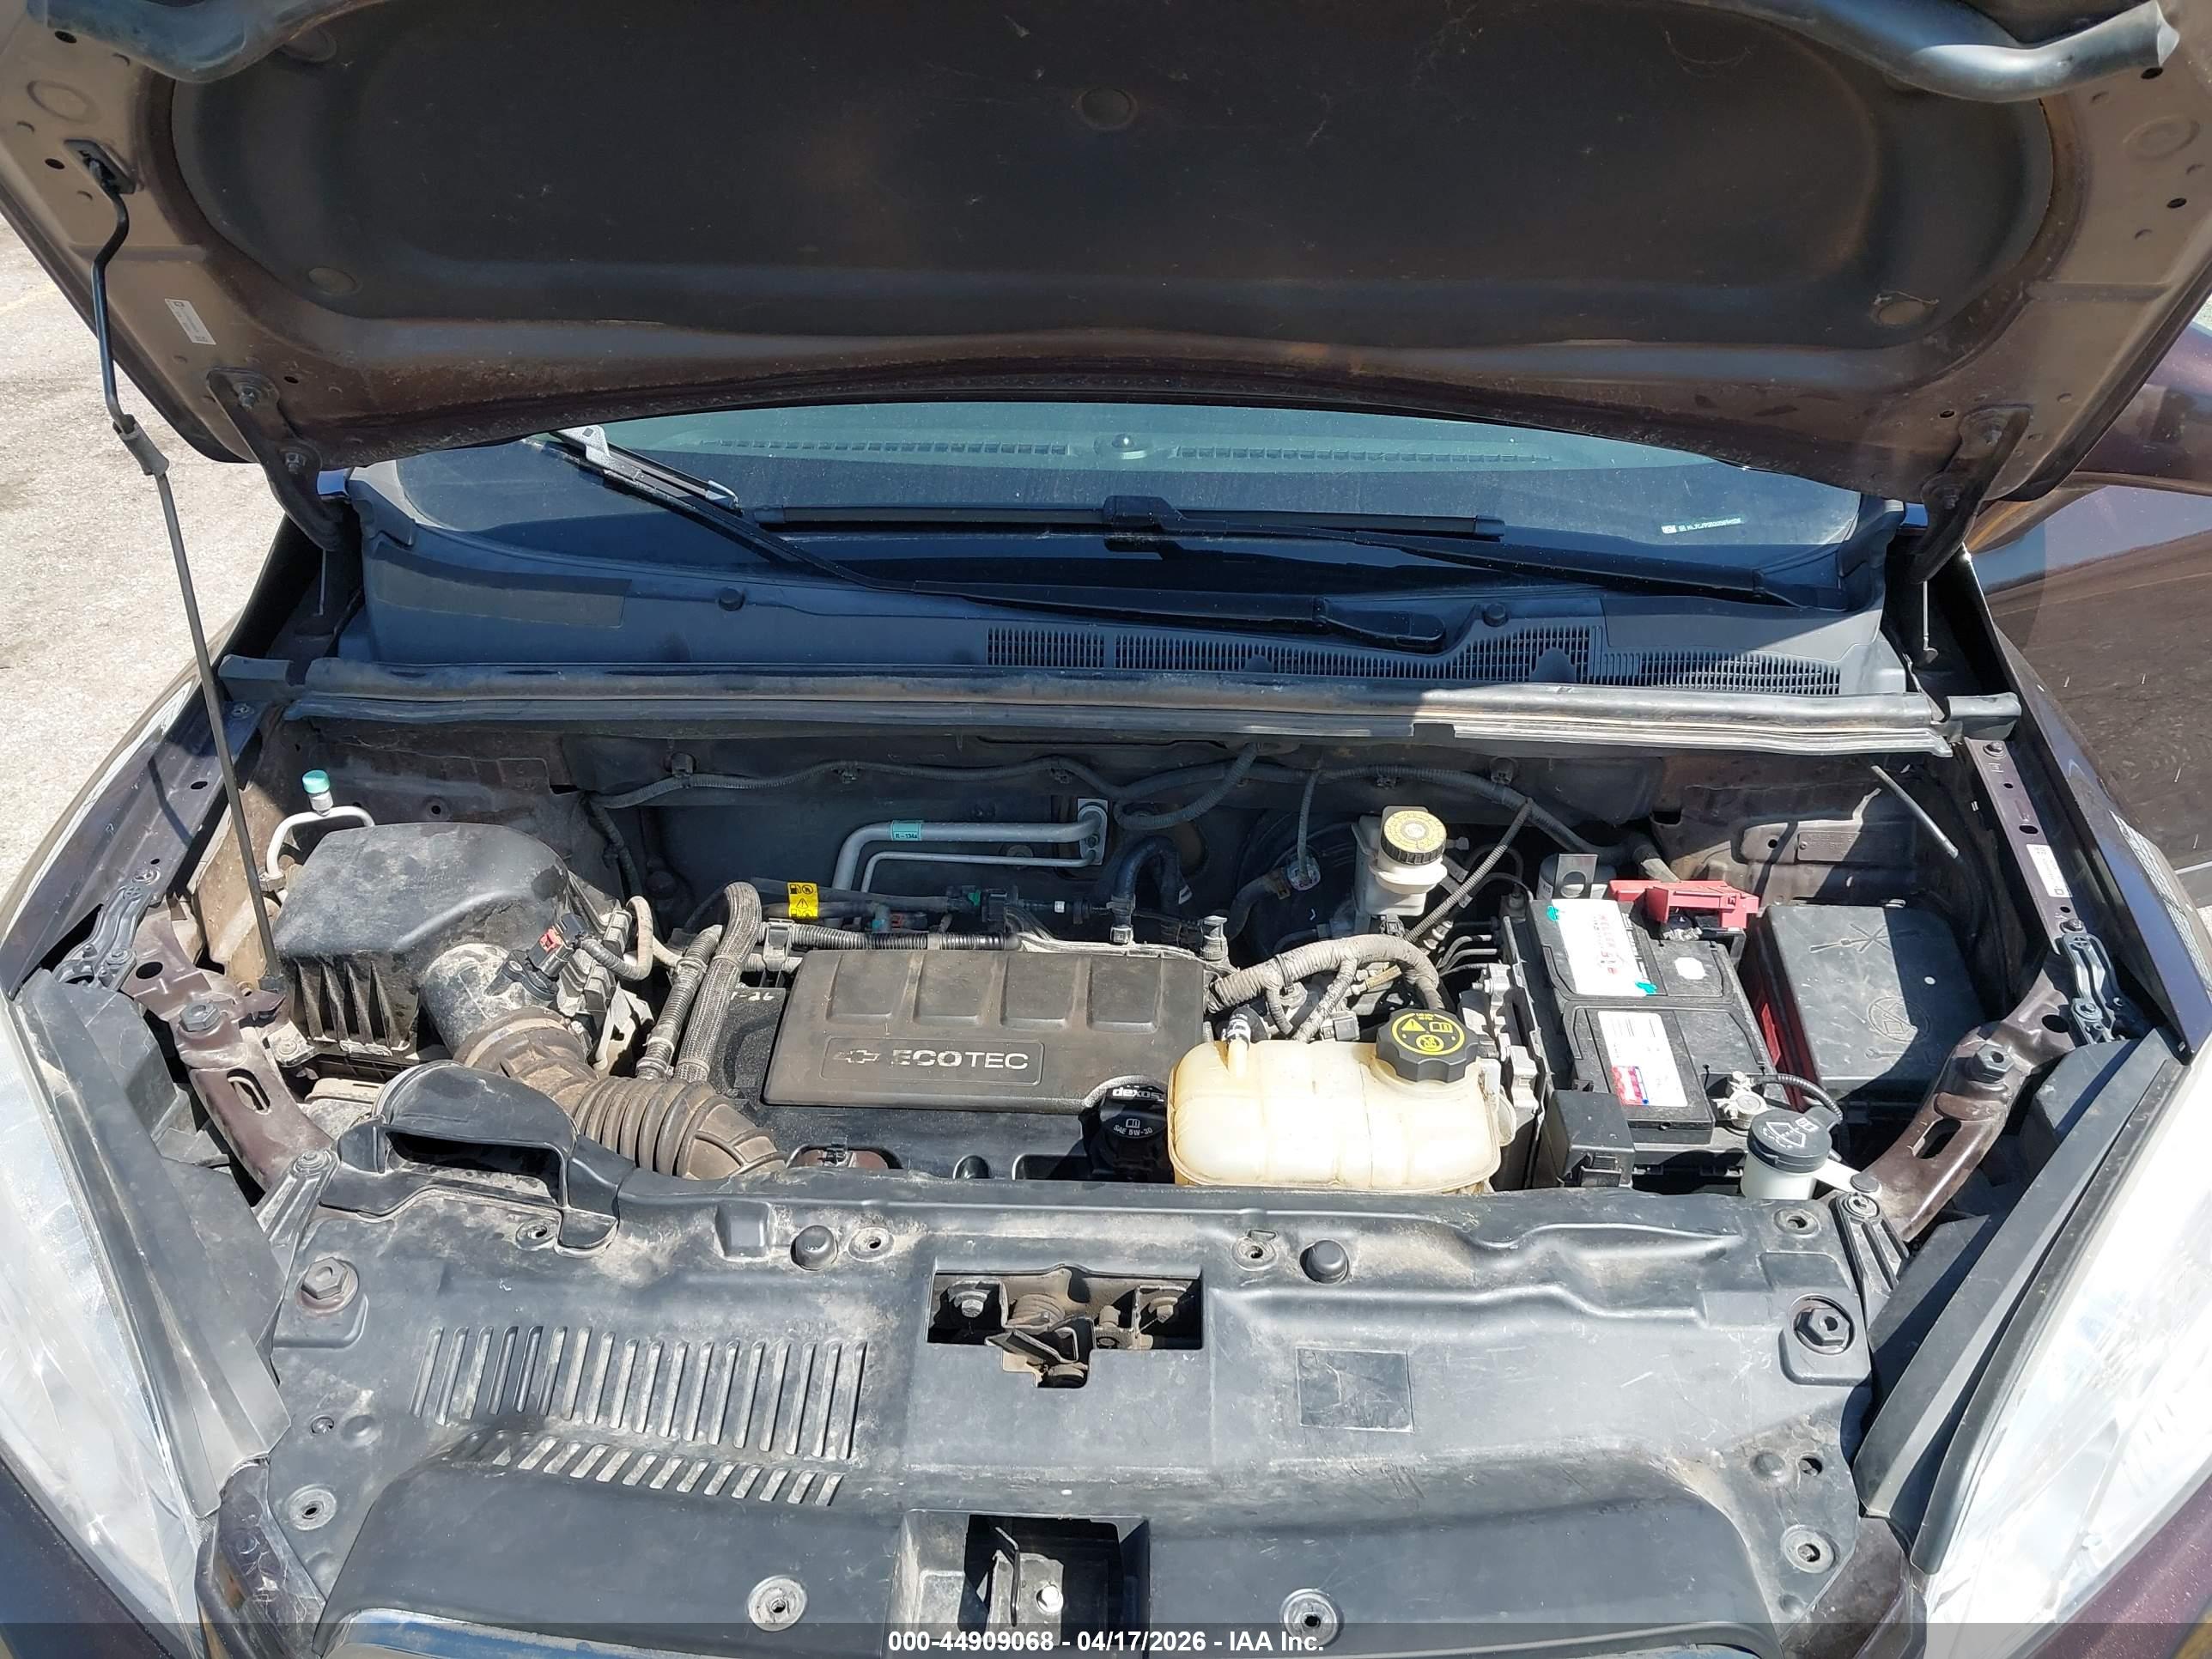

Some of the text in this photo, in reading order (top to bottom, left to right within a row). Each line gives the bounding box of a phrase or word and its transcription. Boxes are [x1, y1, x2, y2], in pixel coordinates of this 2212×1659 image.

[892, 1049, 1029, 1070] ECOTEC
[1113, 1124, 1153, 1136] SAE 5W-30
